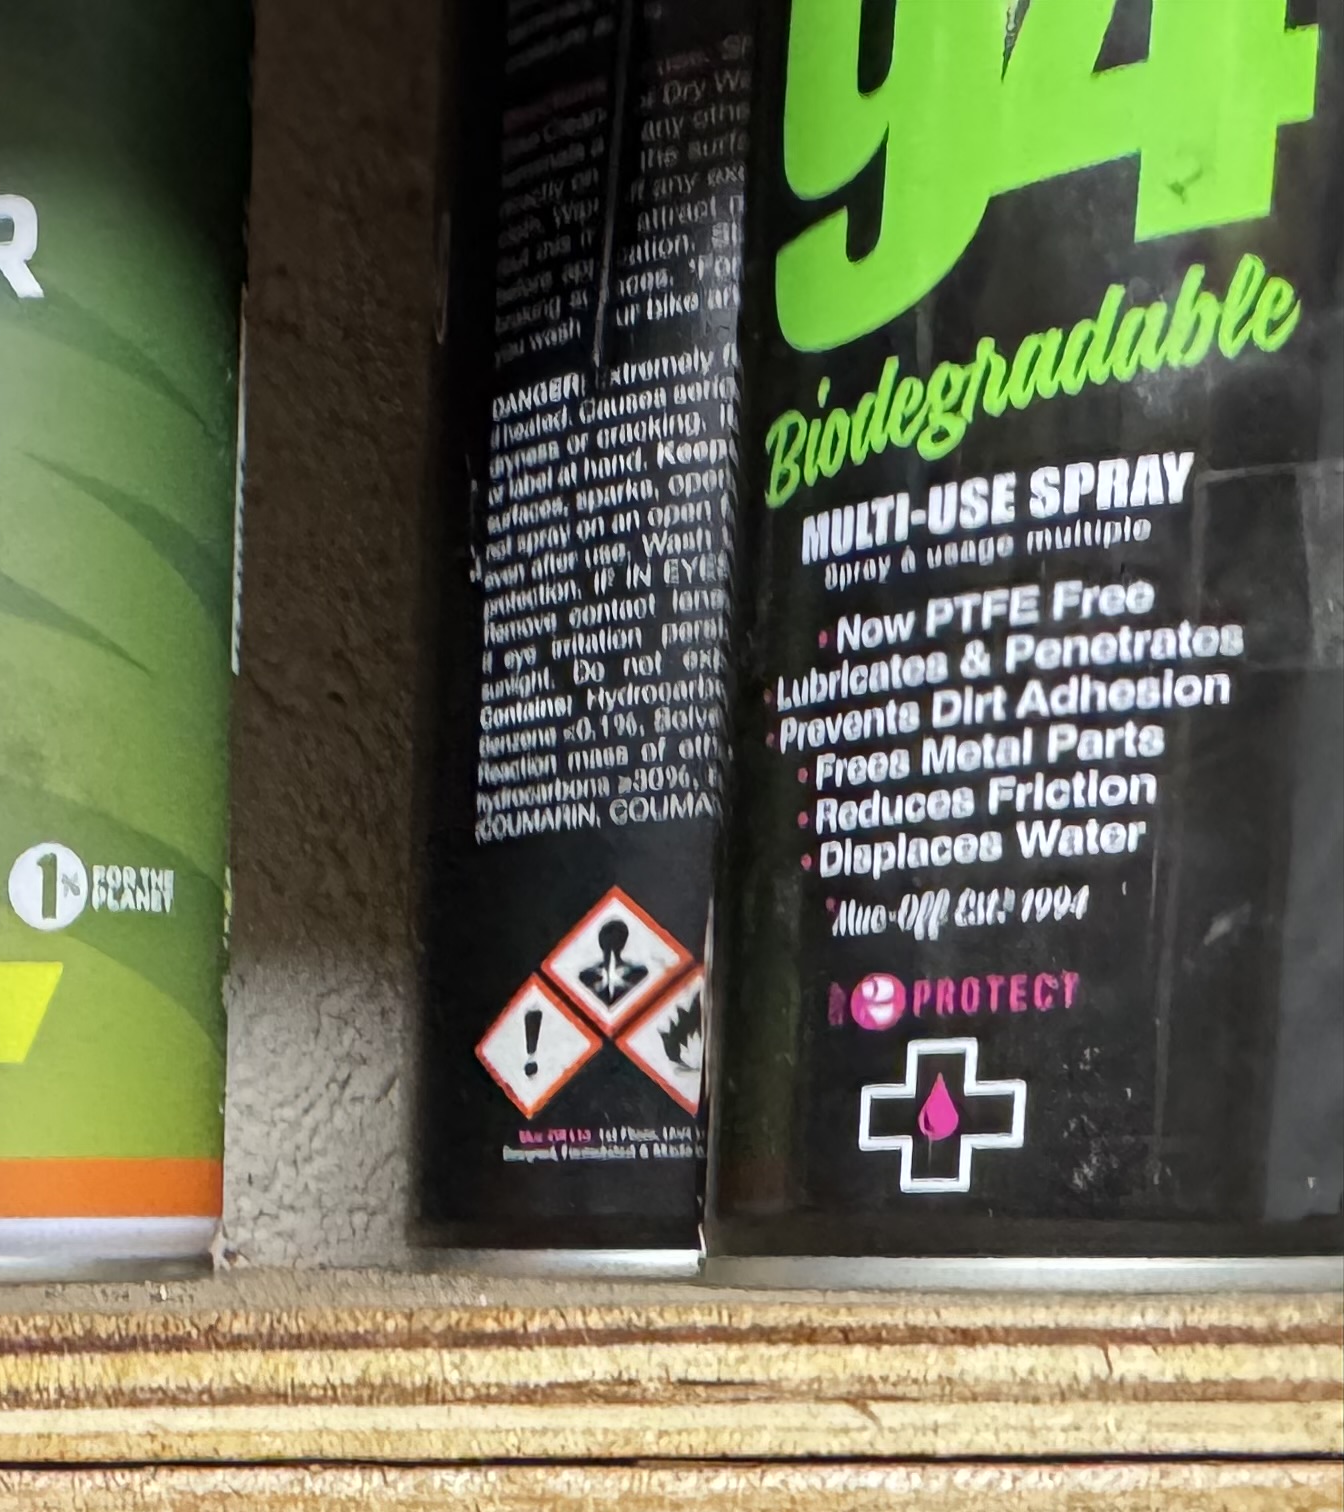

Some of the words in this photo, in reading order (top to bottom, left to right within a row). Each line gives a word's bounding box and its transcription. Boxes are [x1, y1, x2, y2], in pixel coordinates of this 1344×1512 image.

[765, 253, 1302, 510] Biodegradable
[801, 471, 1016, 566] MULTI-USE
[1028, 450, 1196, 519] SPRAY
[835, 609, 916, 656] Now
[924, 584, 1041, 638] PTFE
[1051, 578, 1156, 623] Free
[775, 650, 950, 713] Lubricates
[958, 640, 994, 681] &
[1004, 621, 1247, 675] Penetrates
[778, 699, 921, 756] Prevents
[930, 683, 1009, 730] Dirt
[1014, 667, 1232, 721] Adhesion
[814, 747, 912, 792] Frees
[919, 727, 1034, 778] Metal
[1046, 720, 1166, 765] Parts
[814, 784, 976, 837] Reduces
[987, 769, 1159, 816] Friction
[818, 828, 1005, 881] Displaces
[1015, 818, 1148, 861] Water
[911, 969, 1081, 1019] PROTECT
